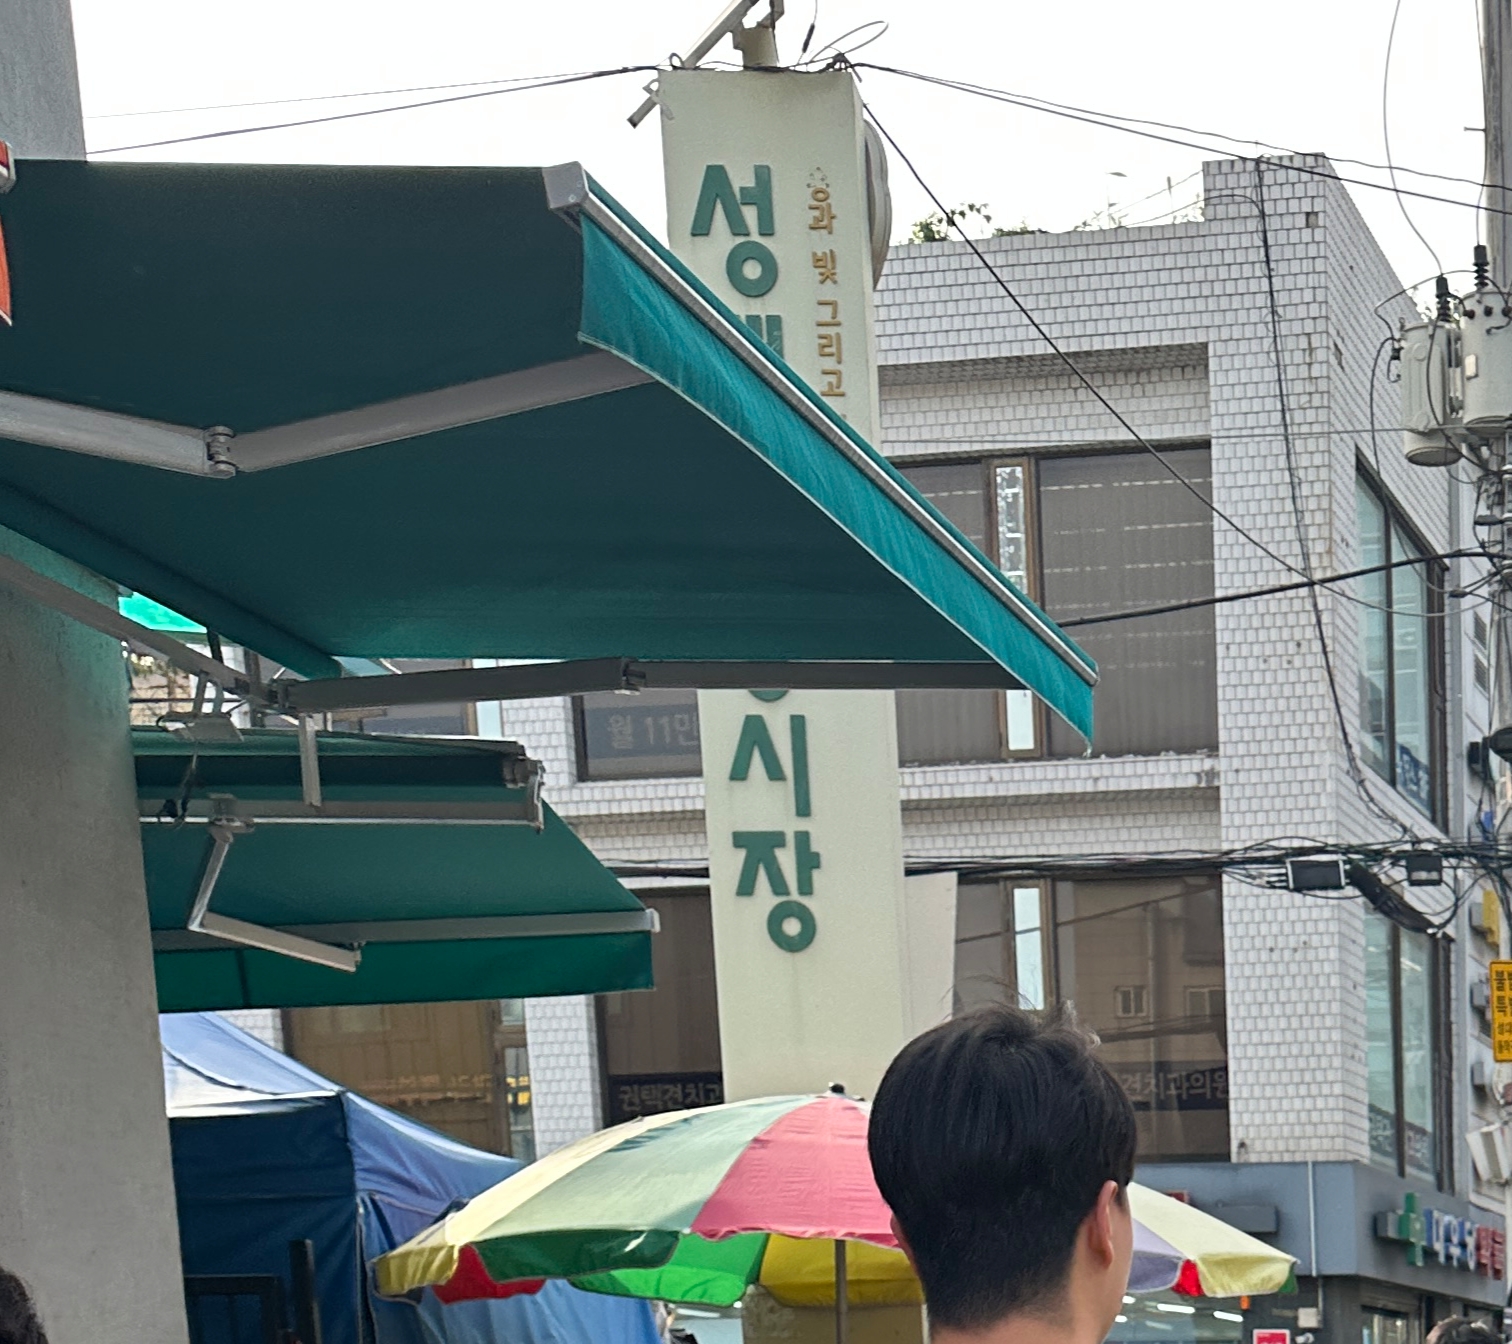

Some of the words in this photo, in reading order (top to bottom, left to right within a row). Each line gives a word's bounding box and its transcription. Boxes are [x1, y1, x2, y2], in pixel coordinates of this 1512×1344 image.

[811, 249, 839, 285] 빛
[814, 299, 846, 397] 그리고
[729, 689, 821, 953] 시장
